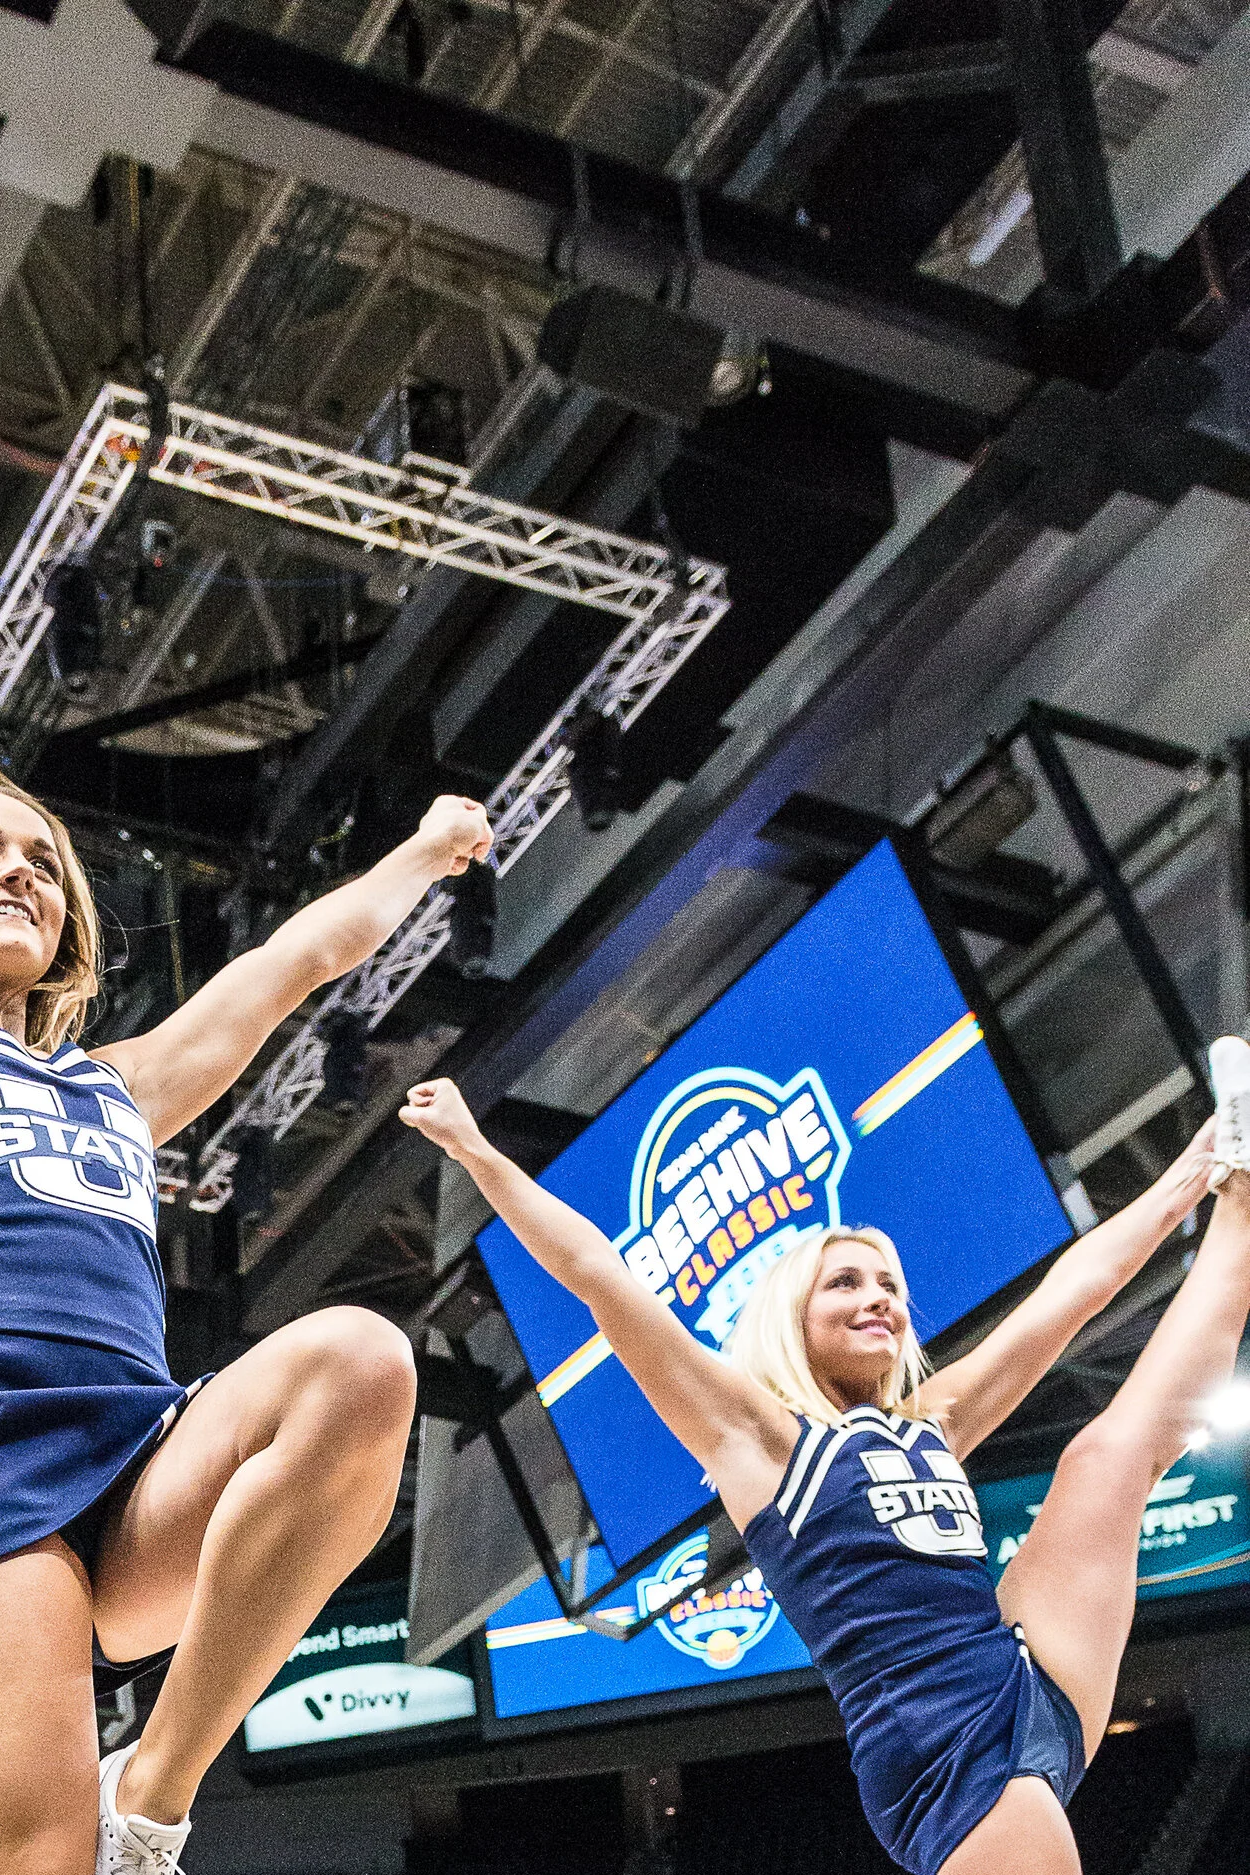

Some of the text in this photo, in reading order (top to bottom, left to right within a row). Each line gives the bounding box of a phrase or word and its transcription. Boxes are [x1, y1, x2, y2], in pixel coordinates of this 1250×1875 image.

[624, 1092, 831, 1293] BEEHIVE
[674, 1174, 814, 1306] CLASSIC
[1142, 1494, 1238, 1537] FIRST
[287, 1618, 410, 1662] end Smart
[342, 1689, 410, 1712] Divvy
